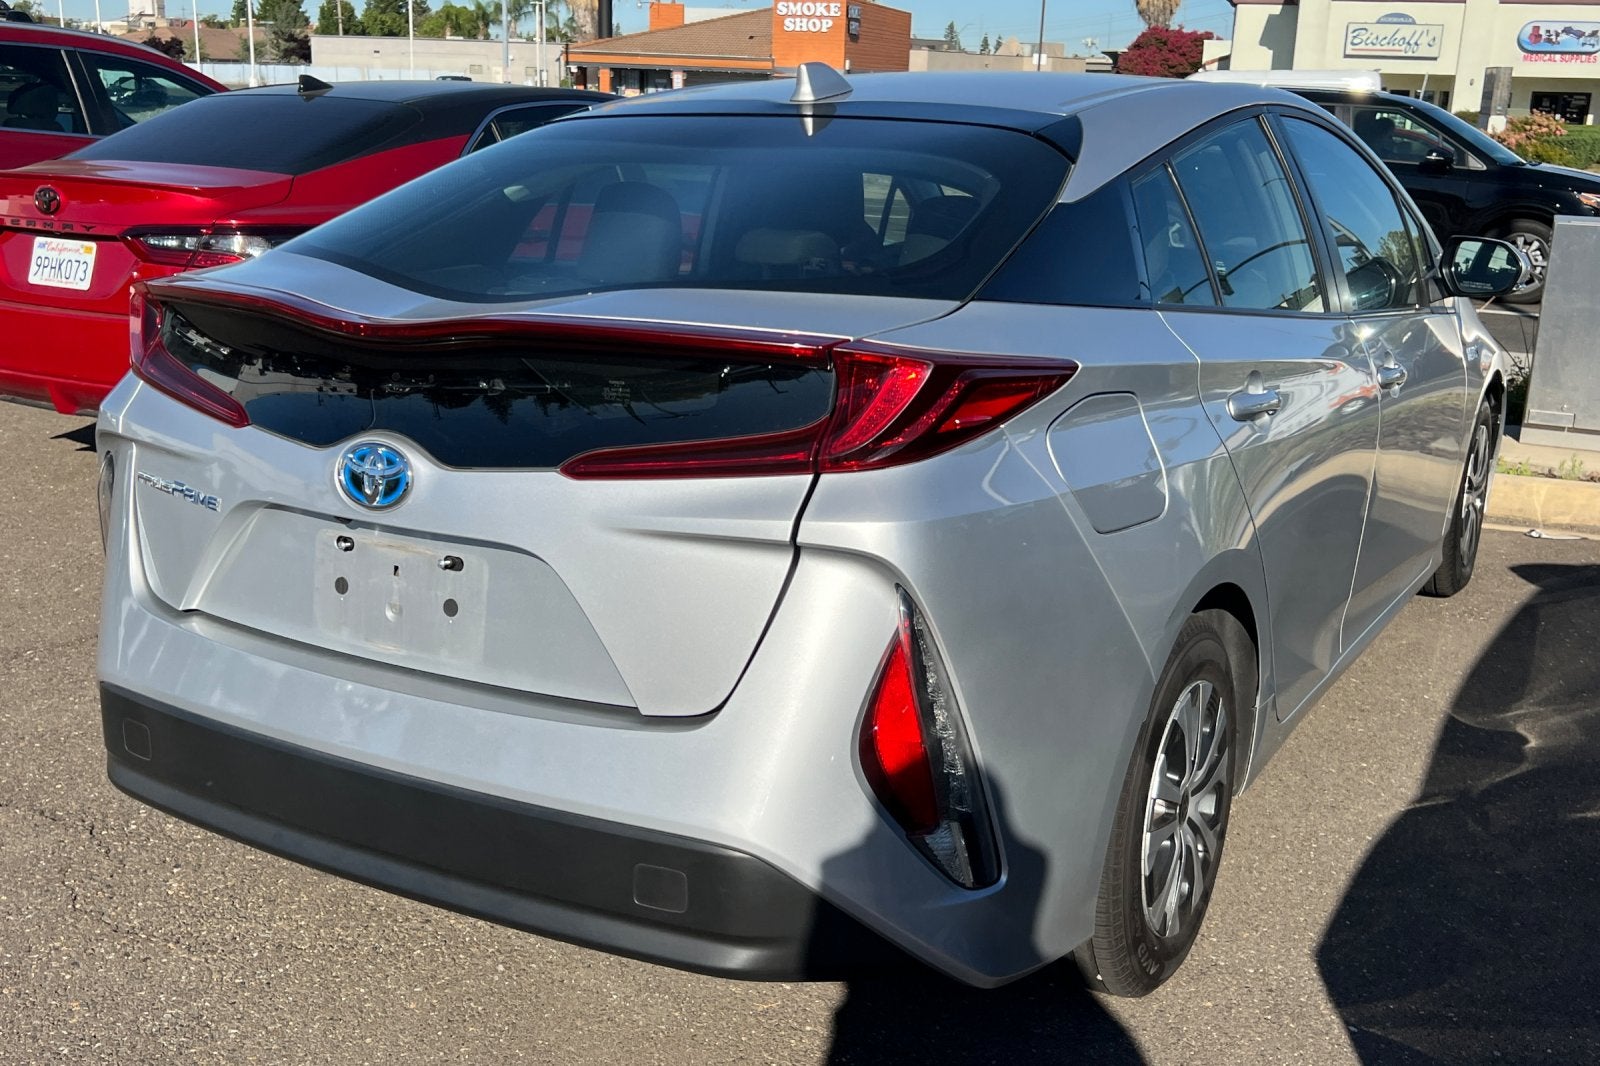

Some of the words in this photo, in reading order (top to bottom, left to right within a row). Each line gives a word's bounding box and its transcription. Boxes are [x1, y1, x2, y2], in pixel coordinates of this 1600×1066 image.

[776, 2, 841, 17] SMOKE
[783, 18, 833, 32] SHOP
[1350, 27, 1437, 54] Bischoff's
[1522, 53, 1557, 63] MEDICAL
[1559, 54, 1598, 64] SUPPLIES
[33, 256, 89, 282] 9PHK073
